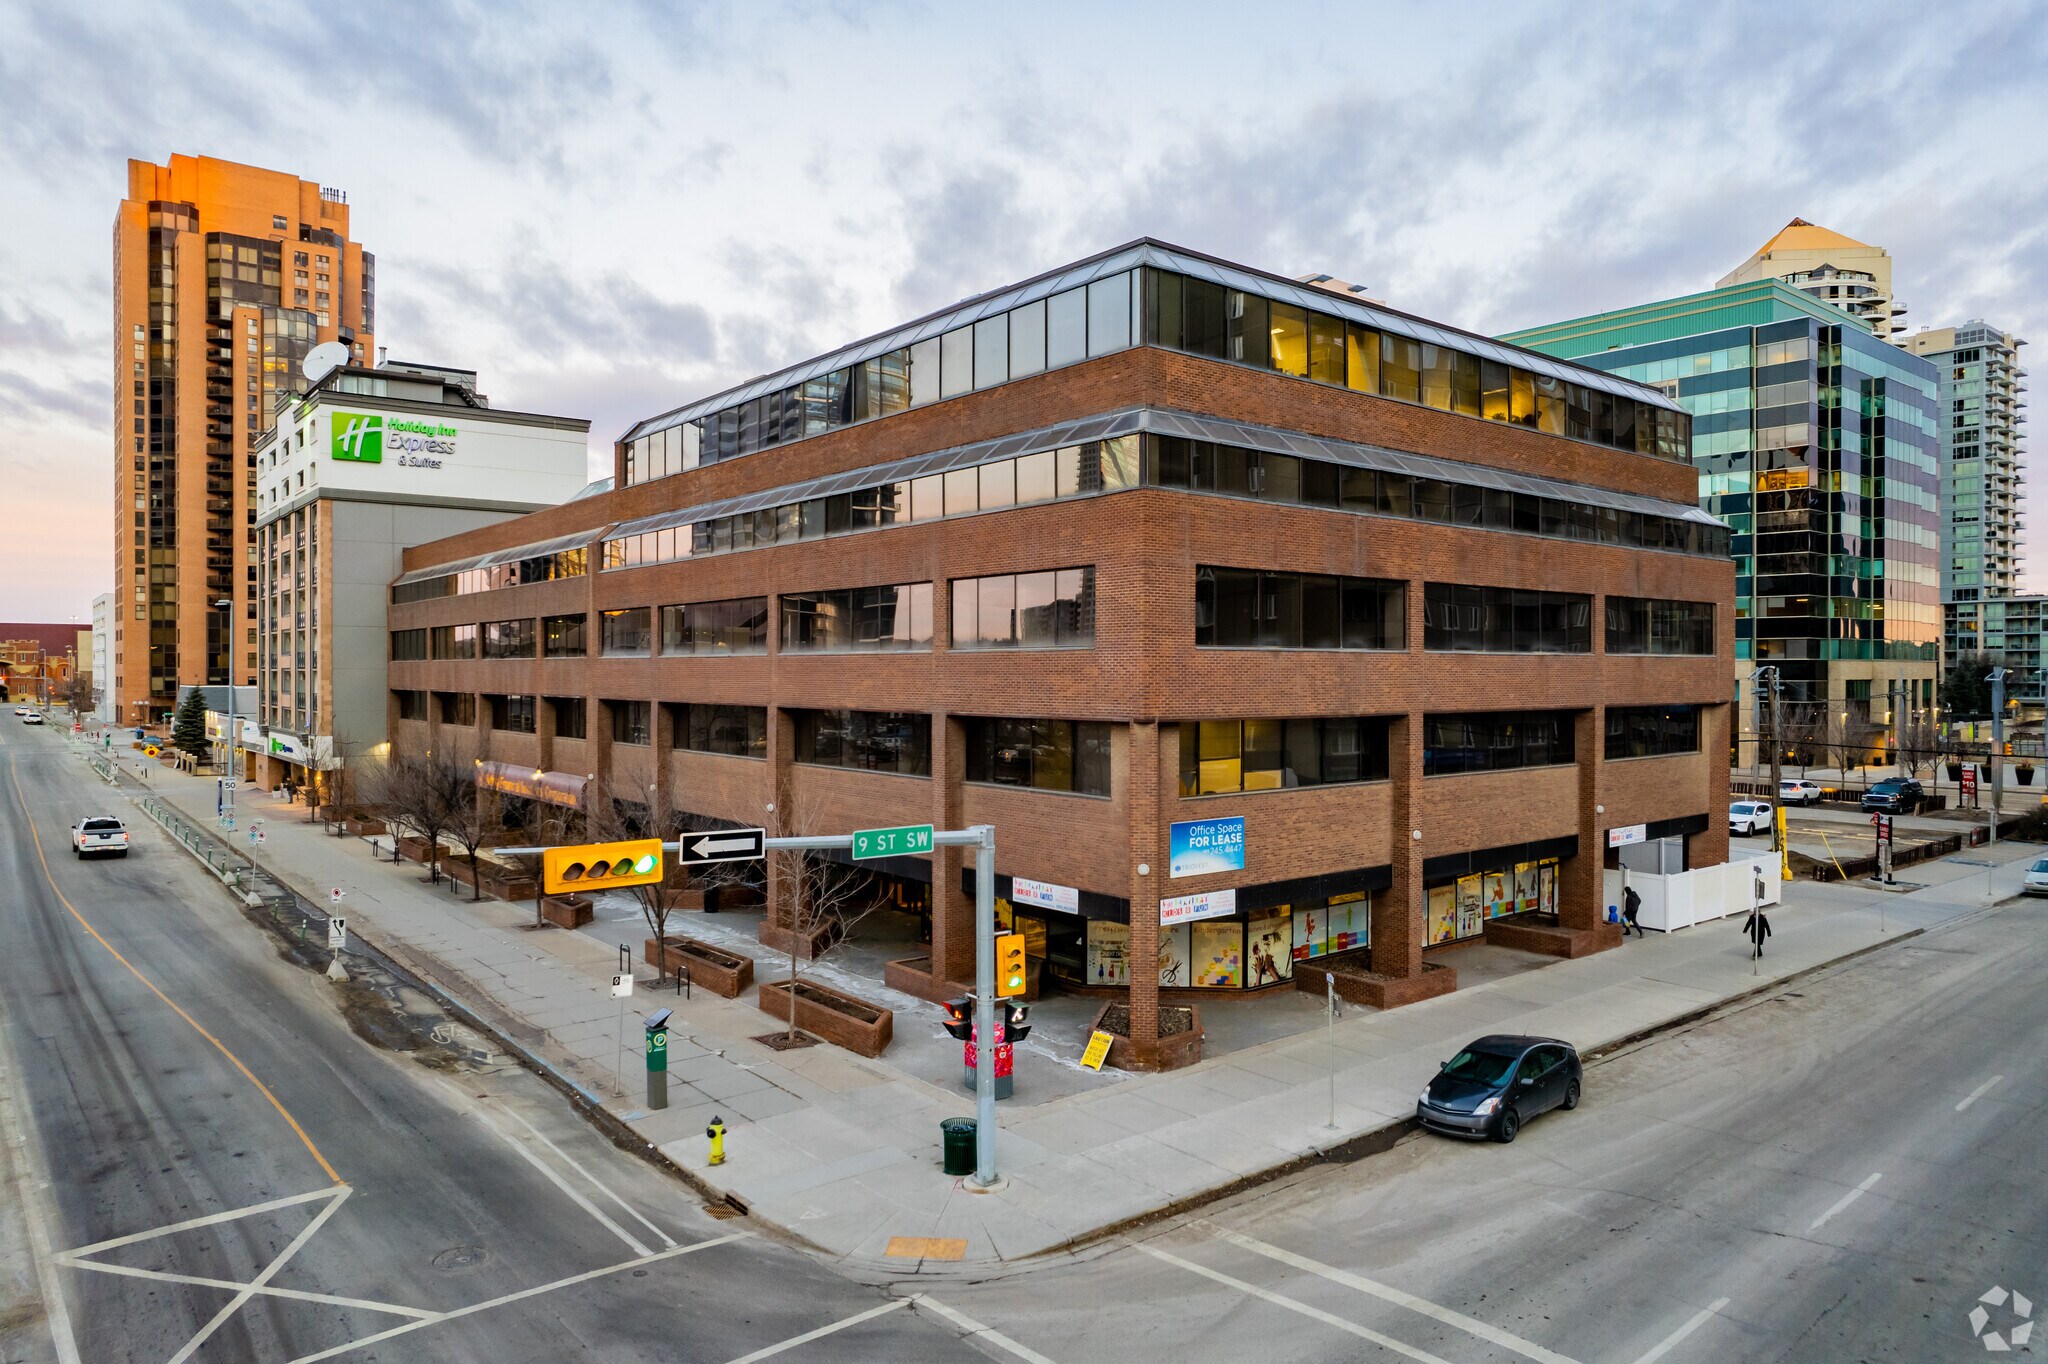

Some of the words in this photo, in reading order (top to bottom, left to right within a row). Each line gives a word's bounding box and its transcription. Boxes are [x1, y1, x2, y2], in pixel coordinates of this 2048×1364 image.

[388, 417, 436, 437] Holiday
[438, 423, 457, 437] Inn
[386, 431, 456, 454] Express
[398, 455, 406, 467] &
[408, 456, 442, 469] Suites
[1190, 826, 1215, 836] Office
[1218, 824, 1242, 835] Space
[858, 837, 868, 853] 9
[877, 834, 896, 851] ST
[906, 831, 928, 848] SW
[1189, 836, 1209, 848] FOR
[1212, 833, 1242, 845] LEASE
[1014, 888, 1031, 896] KIDS
[1040, 892, 1053, 901] FUN
[1162, 908, 1182, 917] KIDS
[1194, 904, 1208, 912] FUN
[1194, 926, 1241, 935] Kindergarten
